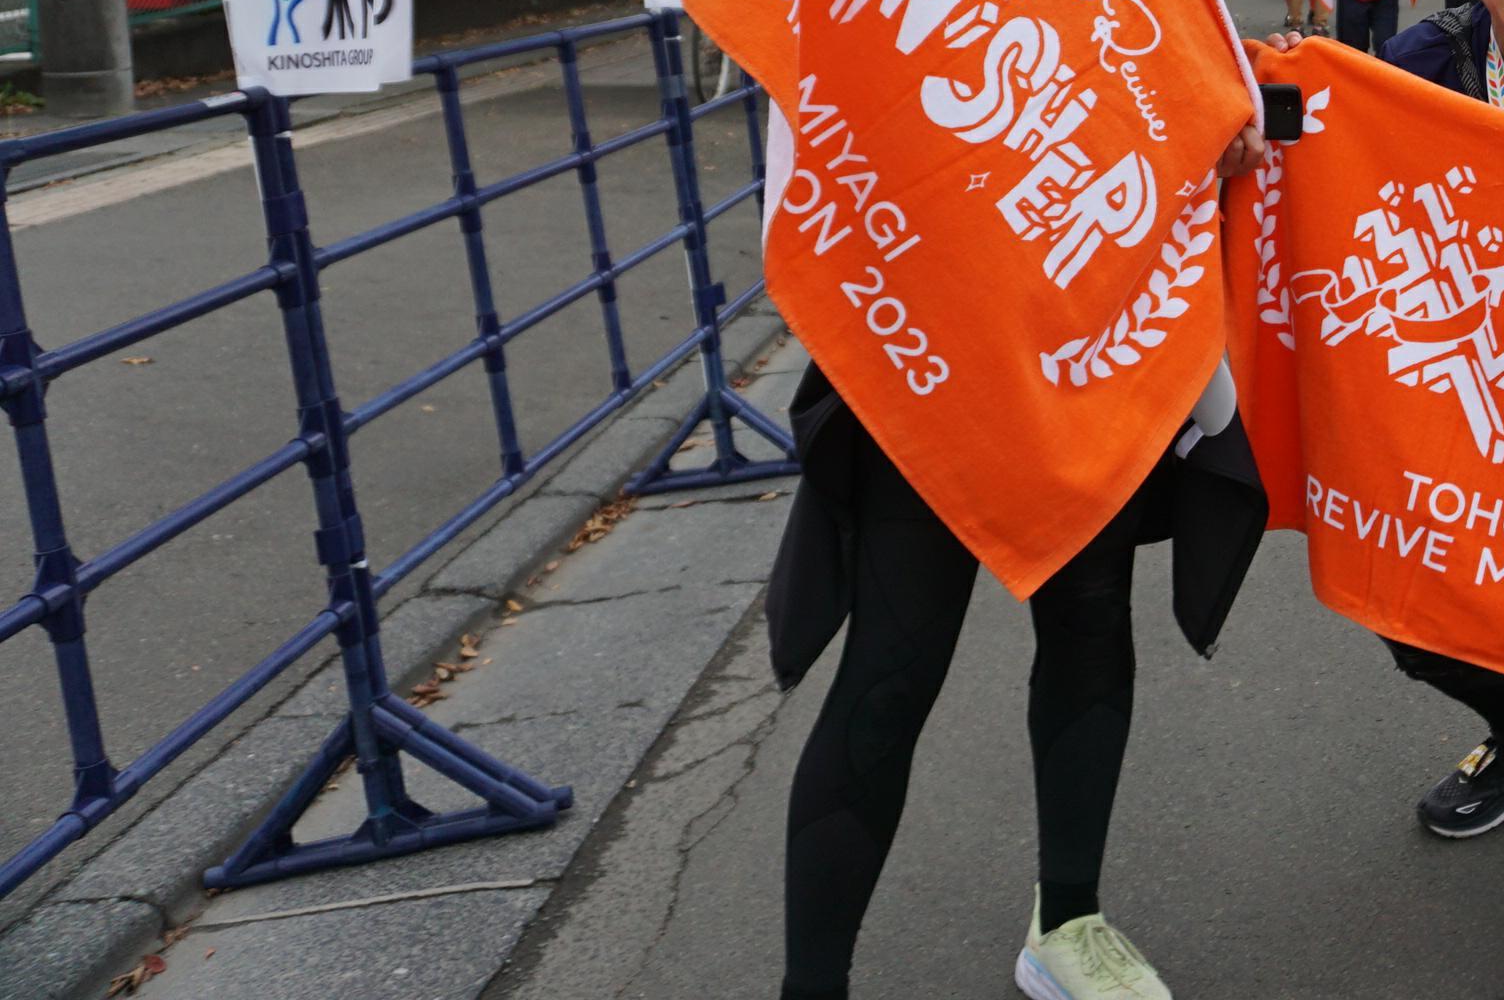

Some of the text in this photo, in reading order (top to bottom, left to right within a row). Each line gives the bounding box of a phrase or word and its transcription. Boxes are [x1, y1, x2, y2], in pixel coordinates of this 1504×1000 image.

[267, 48, 374, 71] KINOSHITA GROUP
[839, 265, 950, 397] 2023
[1305, 475, 1455, 574] REVIVE
